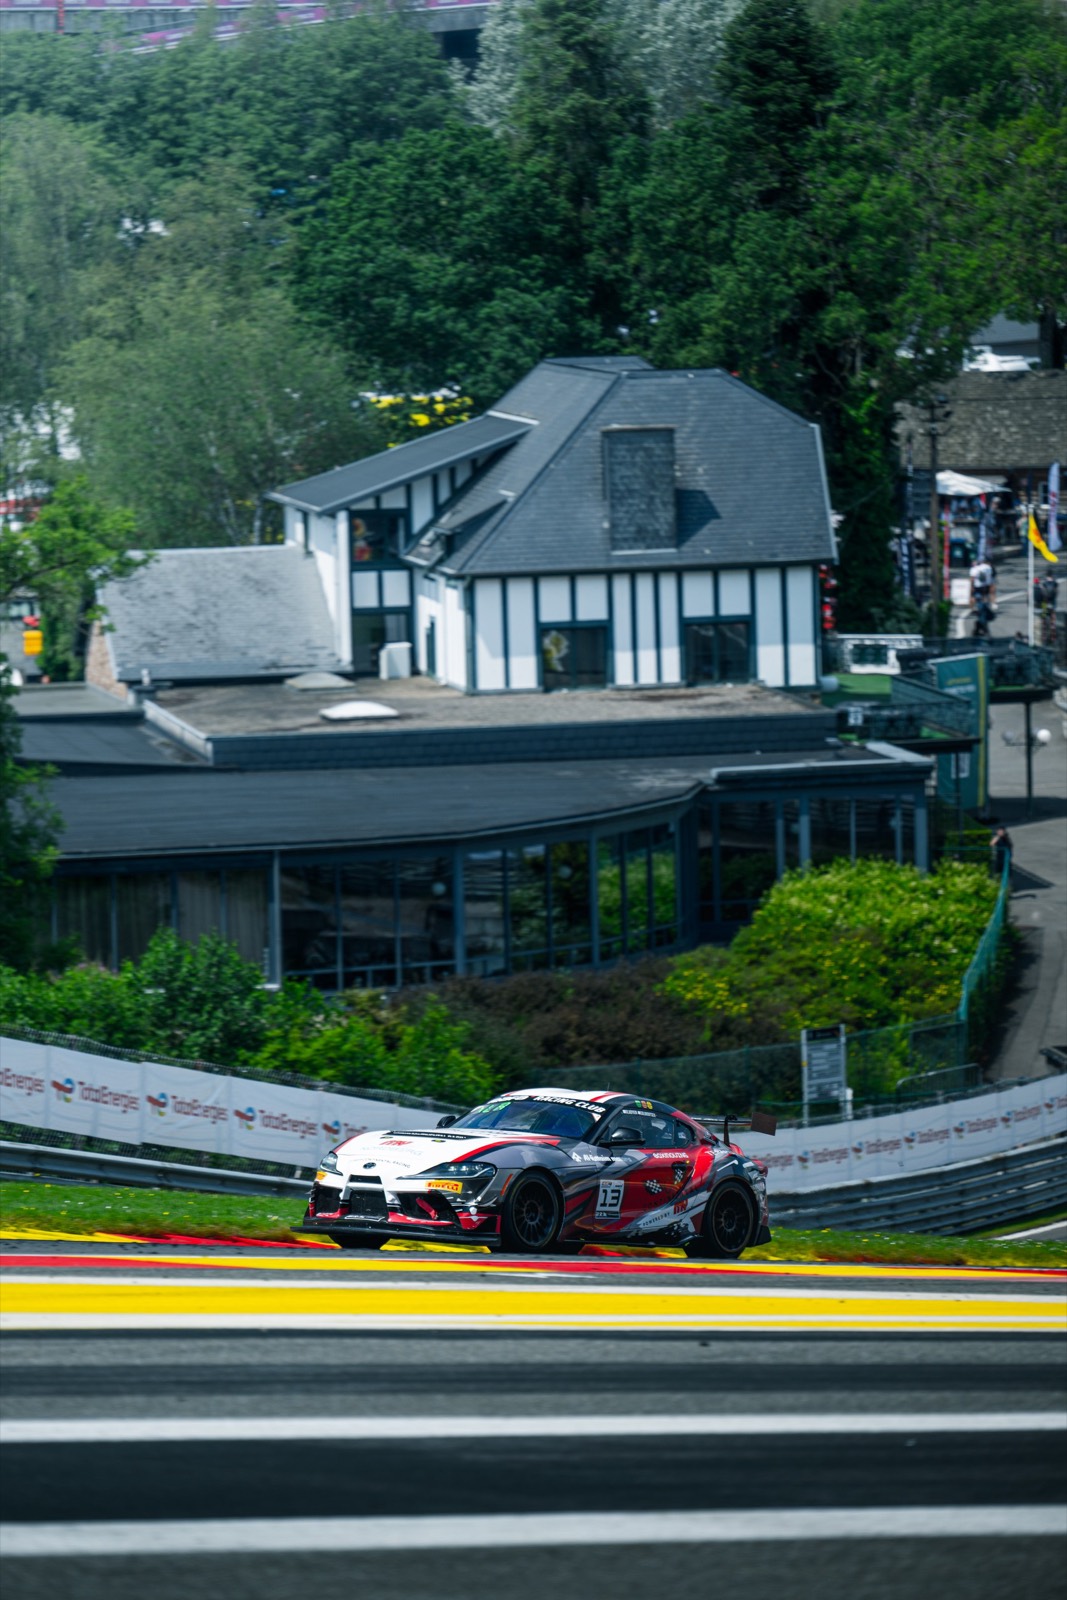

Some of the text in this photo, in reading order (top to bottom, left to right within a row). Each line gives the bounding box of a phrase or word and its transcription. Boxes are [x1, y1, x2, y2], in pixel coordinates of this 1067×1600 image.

[533, 1096, 576, 1105] RACING
[575, 1101, 607, 1113] CLUB
[427, 1181, 459, 1192] PIRELLI
[600, 1189, 621, 1207] 13
